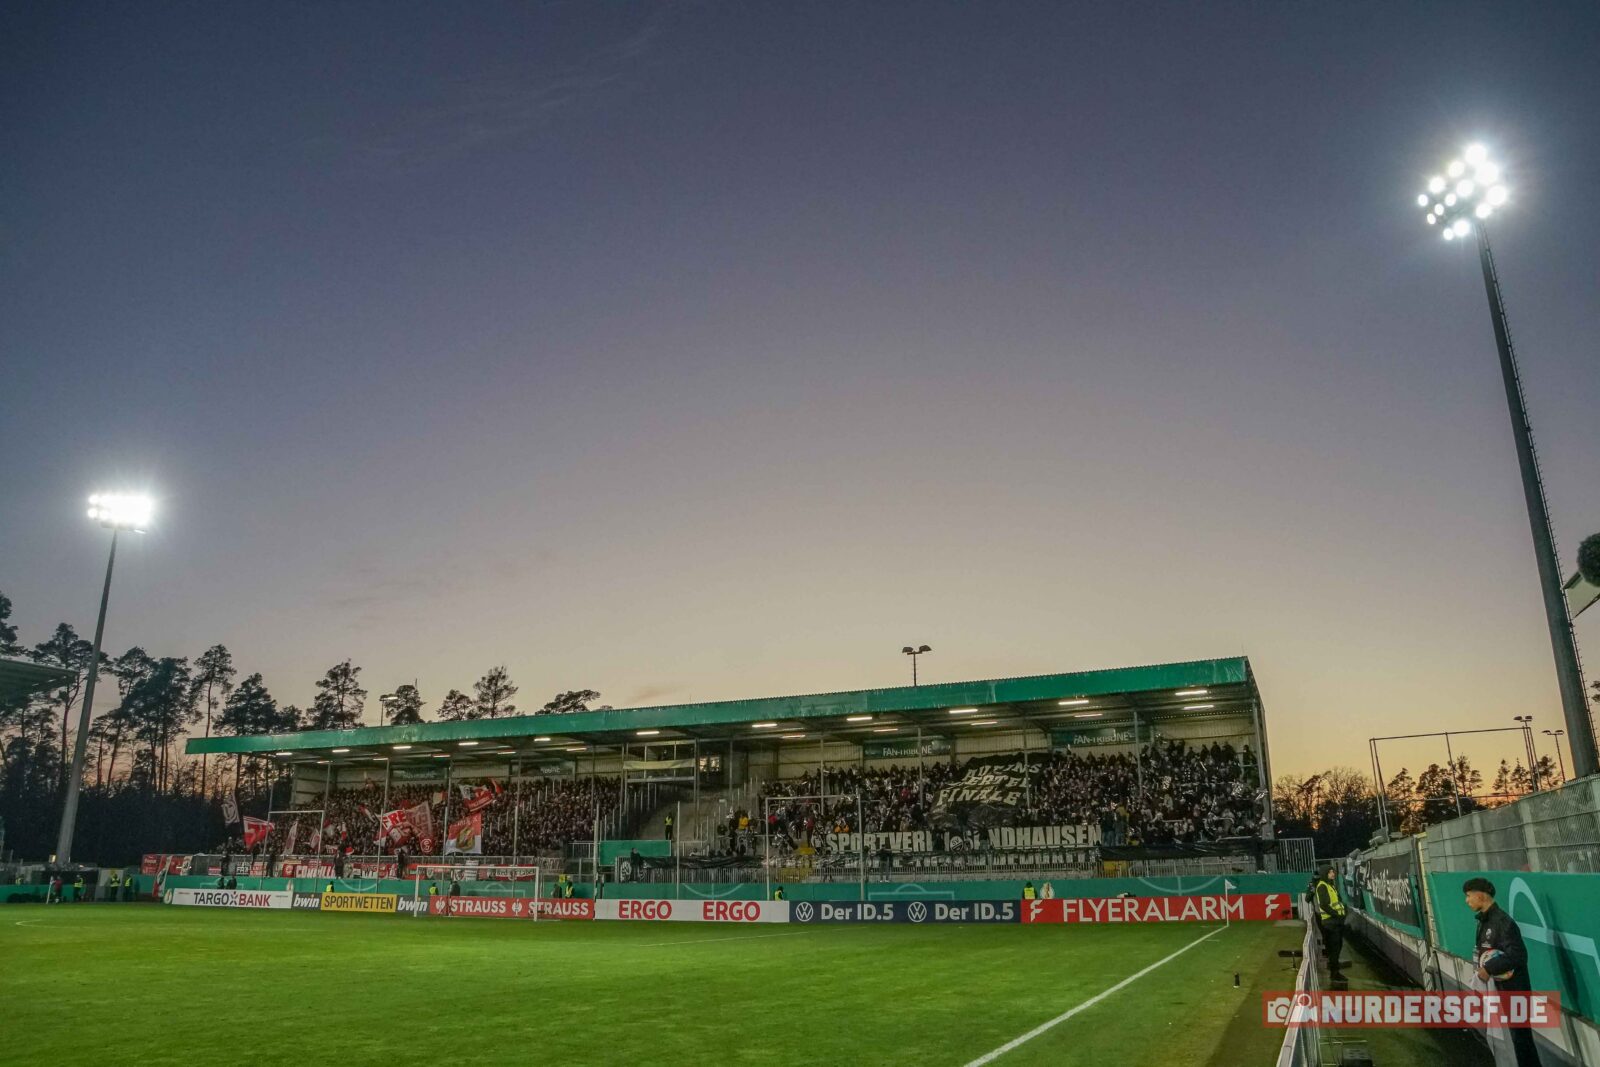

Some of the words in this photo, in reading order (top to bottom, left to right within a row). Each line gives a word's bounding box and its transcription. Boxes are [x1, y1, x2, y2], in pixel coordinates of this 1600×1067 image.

[293, 894, 320, 908] bwin
[325, 896, 393, 910] SPORTWETTEN
[398, 897, 427, 911] bwin
[450, 900, 506, 914] STRAUSS
[528, 901, 588, 916] STRAUSS
[1063, 896, 1244, 922] FLYERALARM
[618, 901, 672, 919] ERGO
[703, 902, 760, 921] ERGO
[821, 904, 852, 920] Der
[857, 904, 894, 920] ID.5
[935, 904, 968, 920] Der
[974, 903, 1014, 920] ID.5
